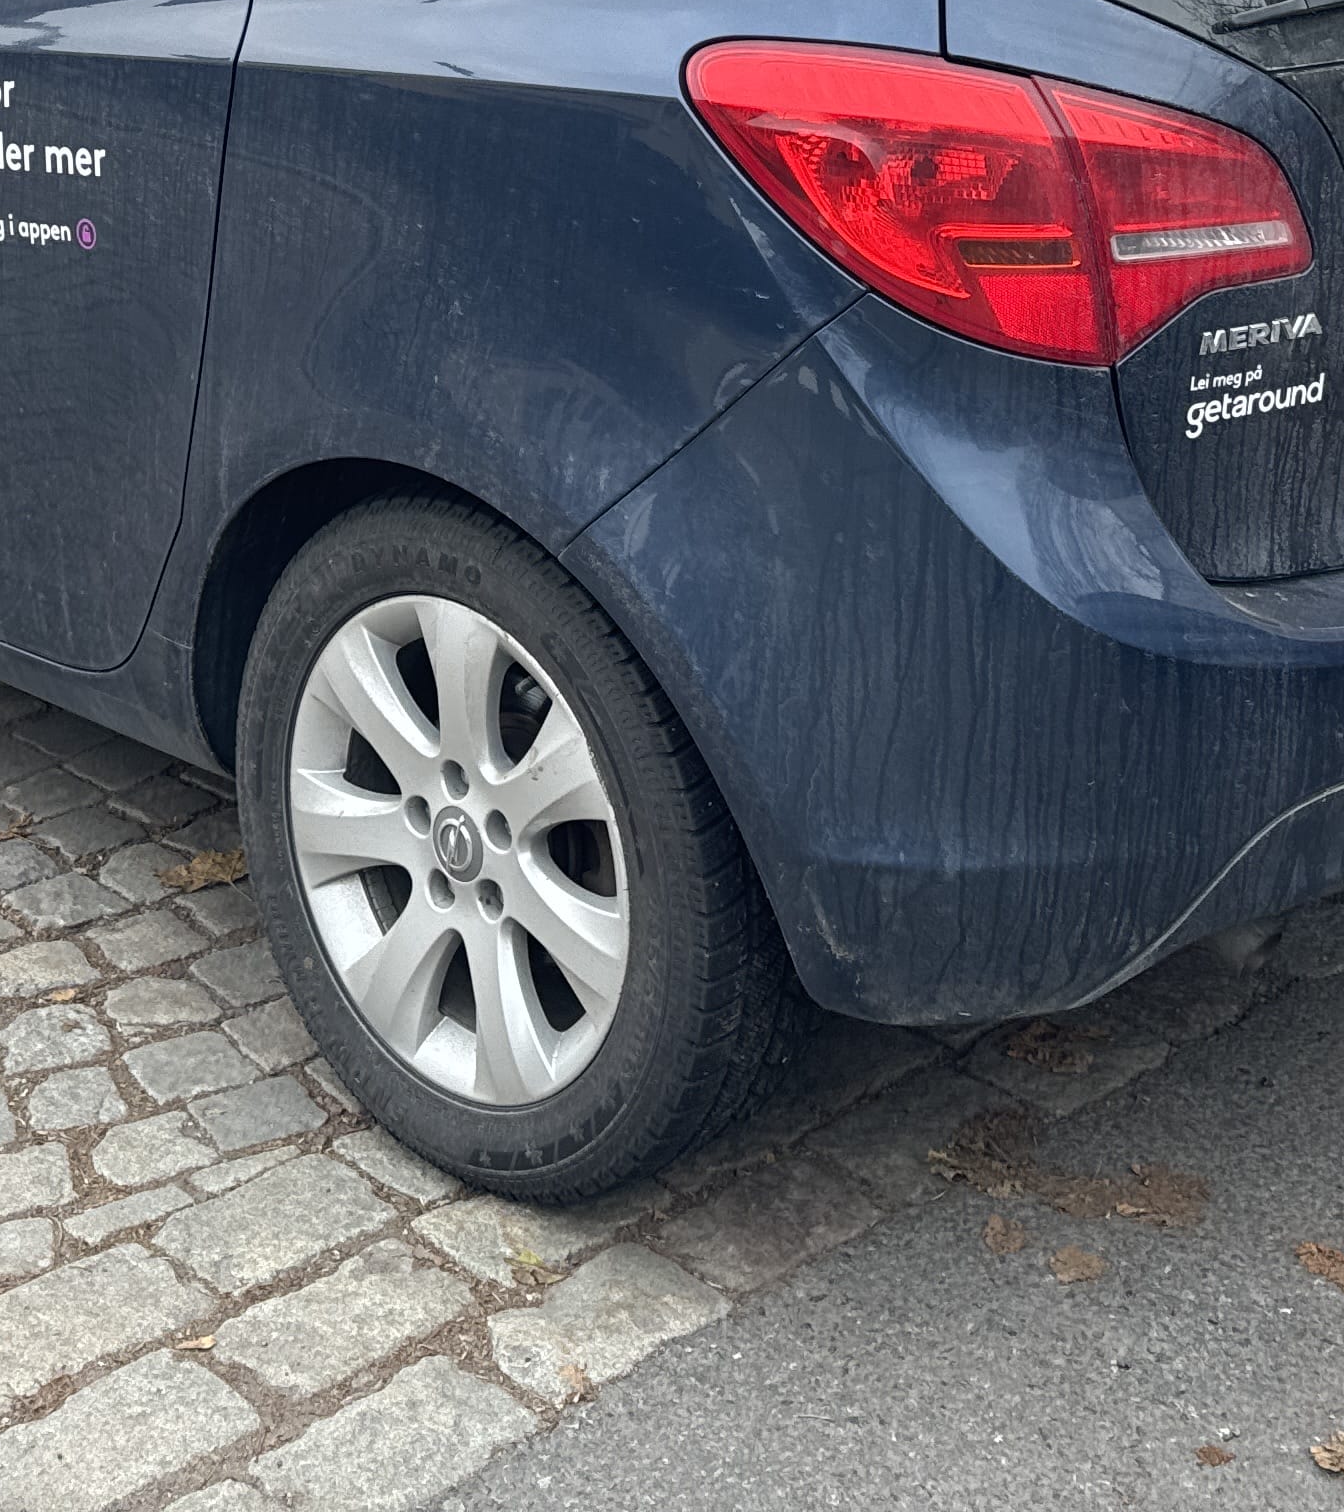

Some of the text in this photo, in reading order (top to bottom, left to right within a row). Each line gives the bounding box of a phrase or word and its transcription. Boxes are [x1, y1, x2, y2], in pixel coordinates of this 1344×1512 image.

[44, 144, 106, 177] mer
[8, 213, 15, 236] i
[18, 220, 72, 246] appen
[1199, 312, 1323, 356] MERIVA
[1190, 364, 1263, 391] Lei meg på
[1185, 372, 1326, 439] getaround
[351, 544, 482, 586] DYNAMO
